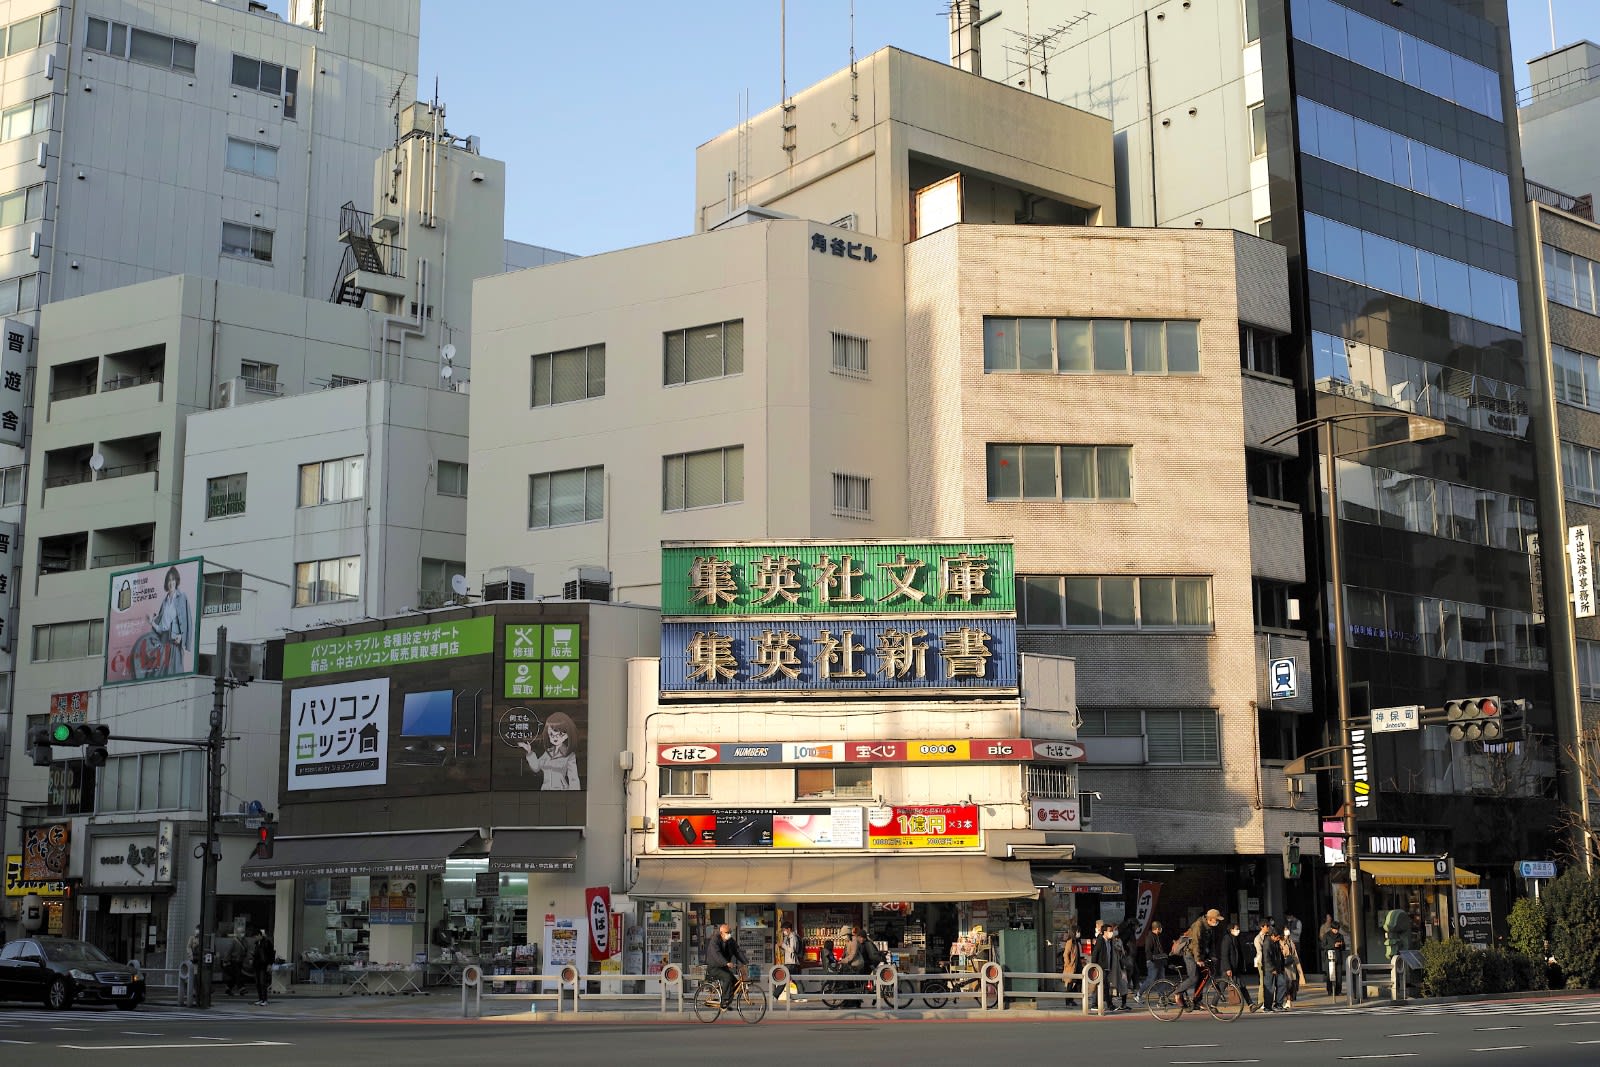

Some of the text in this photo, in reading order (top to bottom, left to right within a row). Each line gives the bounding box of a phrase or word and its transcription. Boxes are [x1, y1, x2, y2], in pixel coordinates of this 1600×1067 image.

[811, 233, 877, 262] 角谷ビル
[2, 331, 24, 431] 晋遊舎
[688, 553, 990, 604] 集英社文庫
[1575, 529, 1590, 613] 井出法律事務所
[311, 626, 459, 657] パソコントラブル 各種設定サポート
[311, 641, 459, 673] 新品・中古パソコン販売買取専門店
[513, 647, 534, 657] 修理
[551, 646, 572, 657] 販売
[686, 627, 992, 681] 集英社新書
[512, 685, 533, 695] 買取
[544, 684, 578, 696] サポート
[298, 694, 380, 726] パソコン
[672, 748, 707, 760] たばこ
[733, 747, 769, 757] NUMBERS
[856, 745, 896, 758] 宝くじ
[920, 744, 957, 754] toto
[1045, 745, 1073, 757] たばこ
[1351, 730, 1370, 807] DOUTOR
[897, 815, 946, 834] 1億円
[1049, 808, 1076, 822] 宝くじ
[1370, 835, 1416, 854] DOUTOR
[592, 901, 606, 947] たばこ
